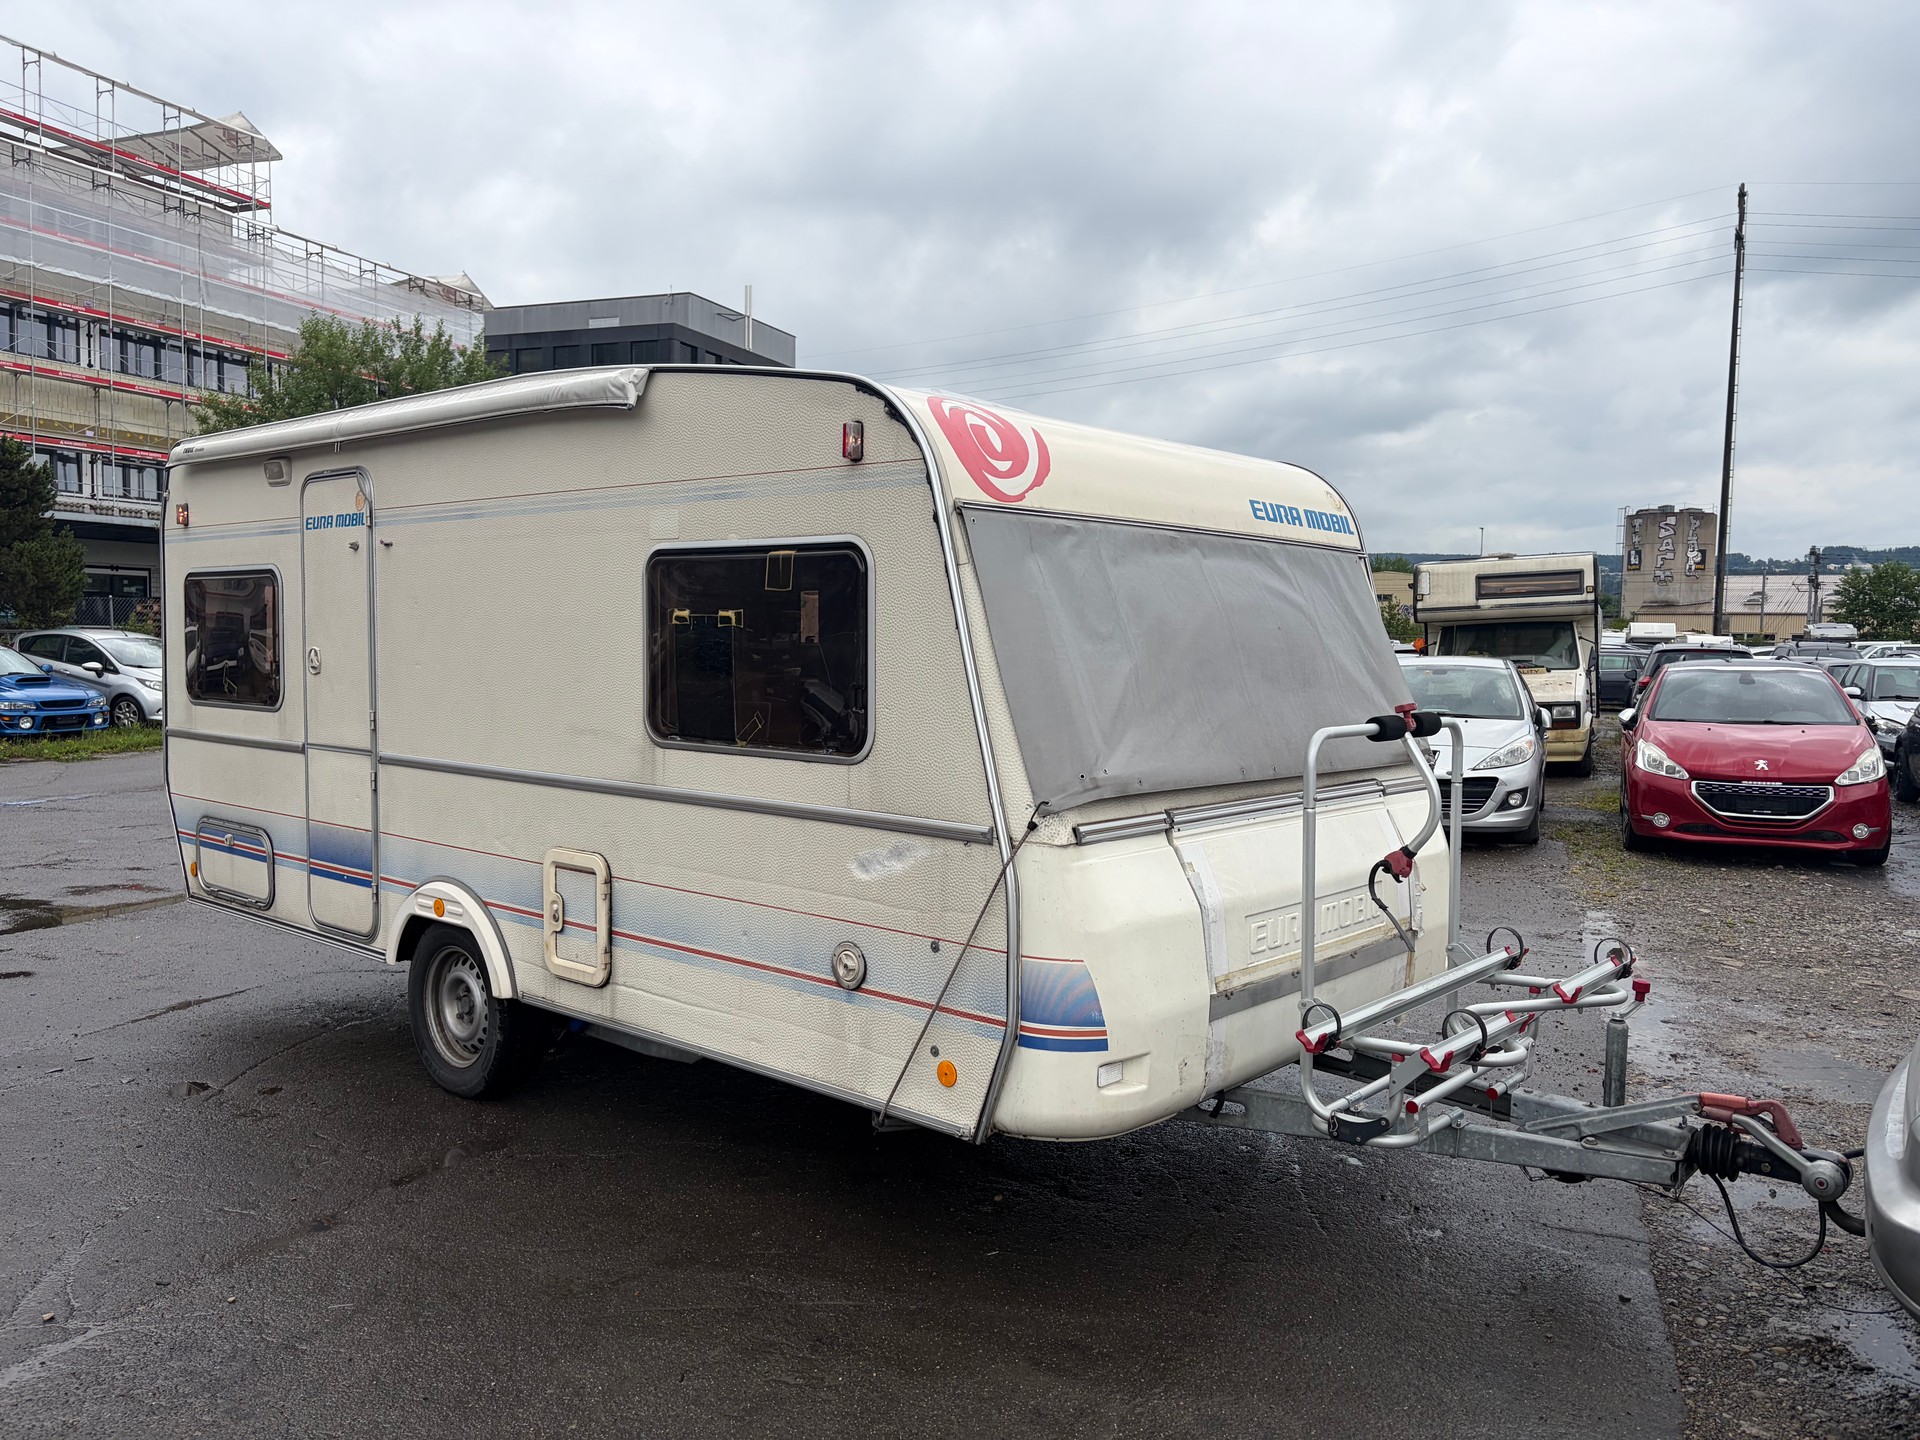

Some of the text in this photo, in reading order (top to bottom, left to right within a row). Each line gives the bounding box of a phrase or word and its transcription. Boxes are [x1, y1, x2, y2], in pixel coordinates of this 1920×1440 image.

[305, 512, 366, 530] EURA MOBIL
[1248, 499, 1355, 536] EURA MOBIL
[1249, 911, 1306, 955] EUR
